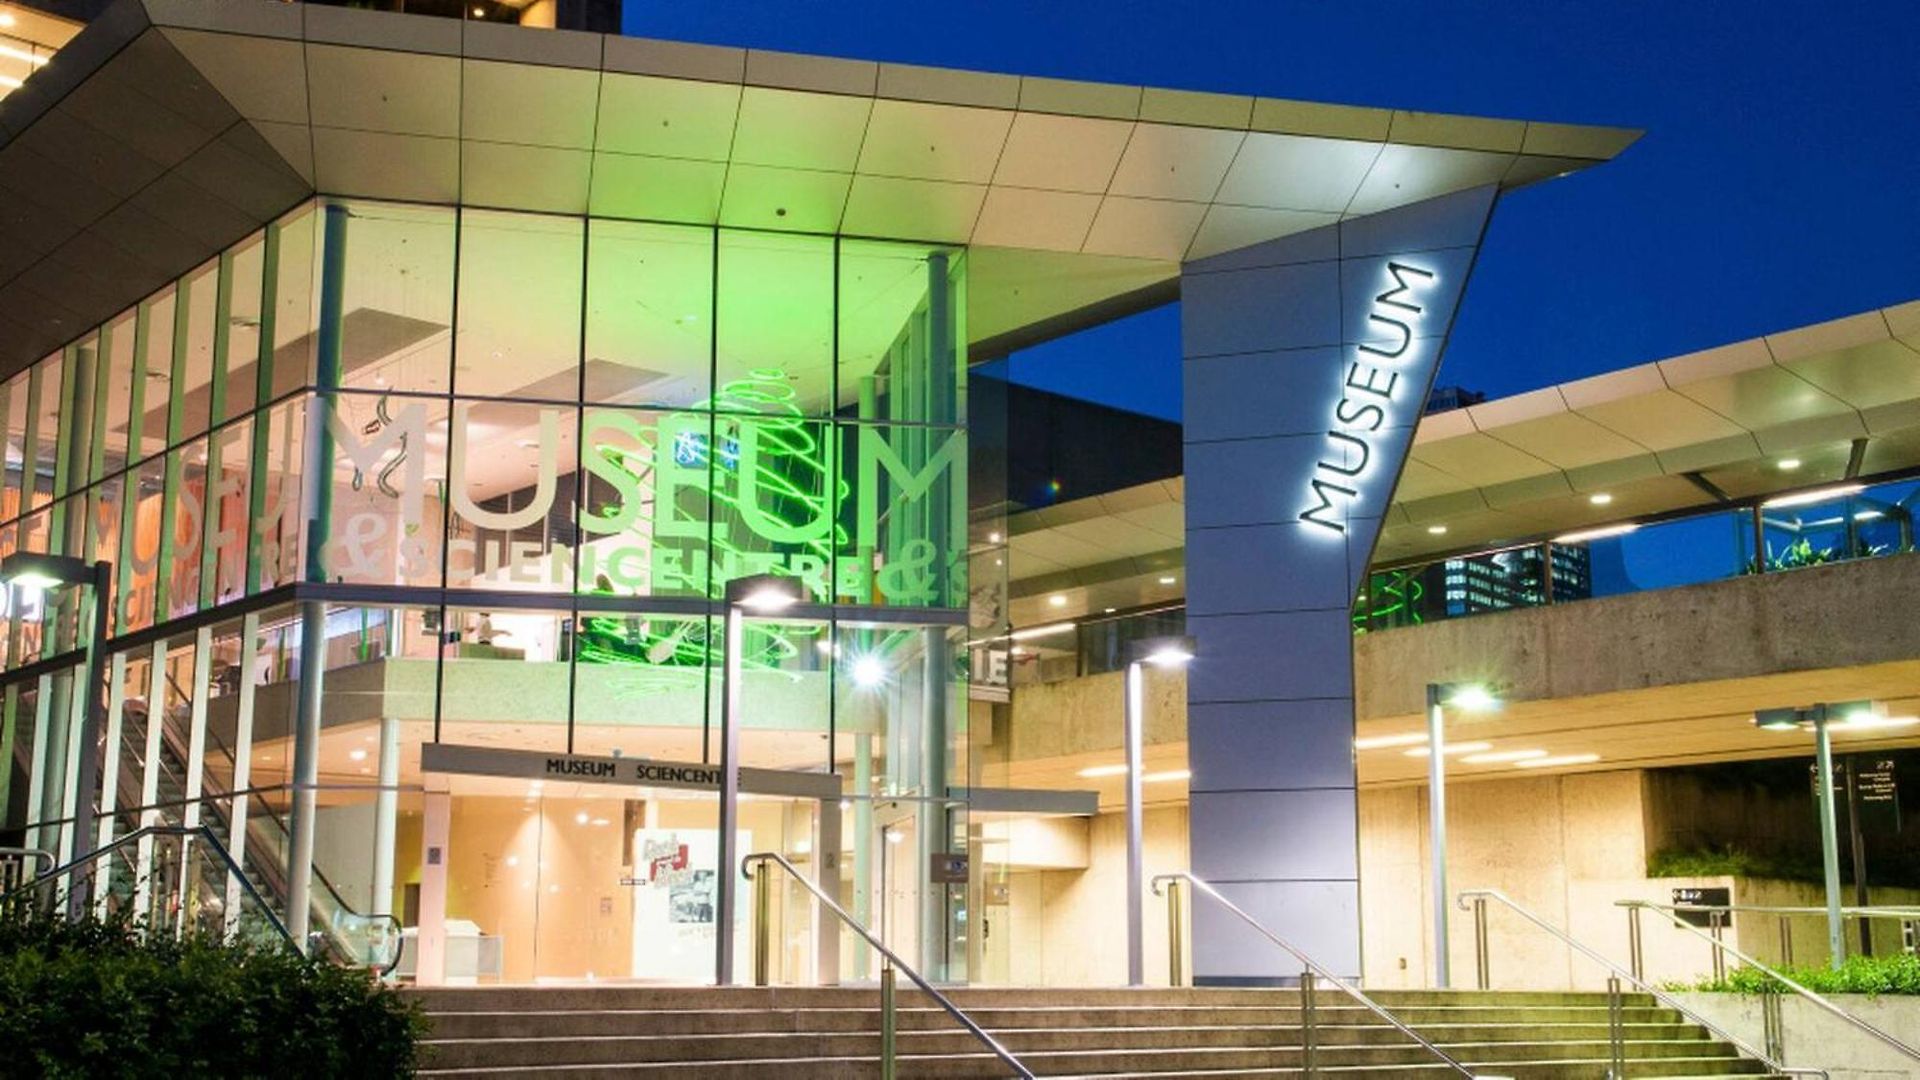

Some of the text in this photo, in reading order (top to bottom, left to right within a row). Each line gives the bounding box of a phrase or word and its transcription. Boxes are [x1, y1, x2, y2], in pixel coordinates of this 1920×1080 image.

[1298, 261, 1434, 532] MUSEUM
[306, 397, 967, 550] MUSEUM
[546, 759, 742, 787] MUSEUM SCIENCENT
